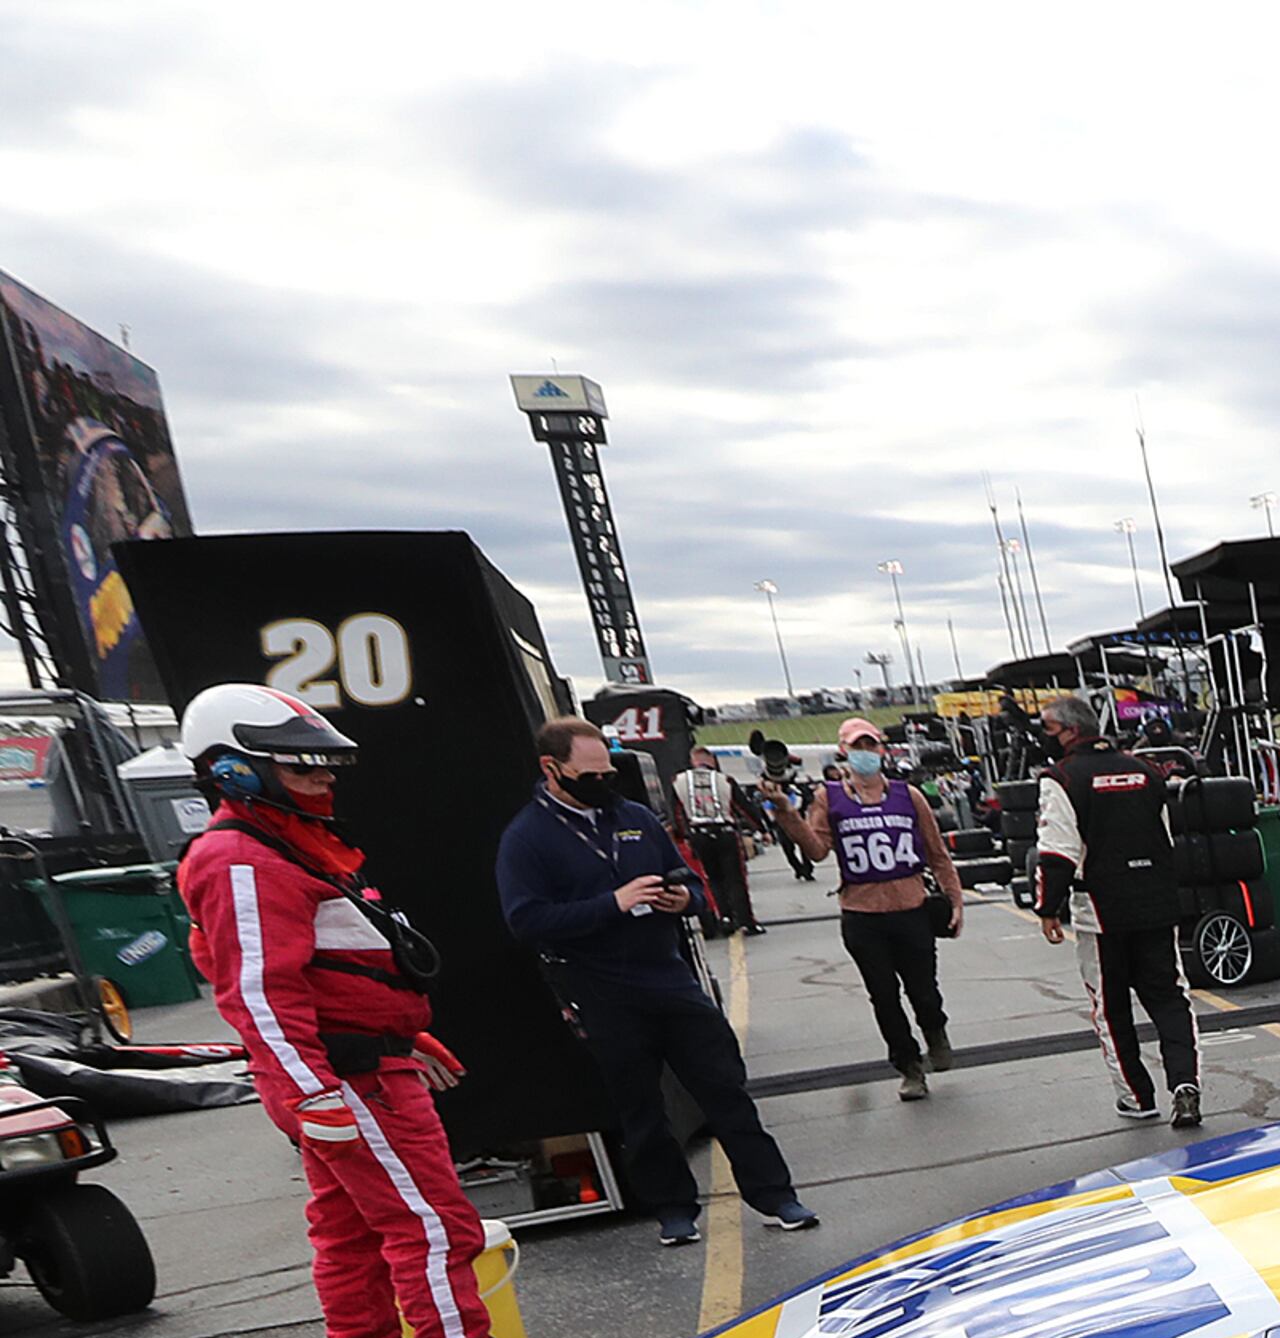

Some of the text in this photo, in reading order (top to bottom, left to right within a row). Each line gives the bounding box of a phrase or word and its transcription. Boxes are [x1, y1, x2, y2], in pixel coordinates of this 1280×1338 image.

[259, 613, 411, 709] 20
[612, 705, 666, 741] 41
[1092, 773, 1147, 792] ECR
[841, 831, 920, 874] 564
